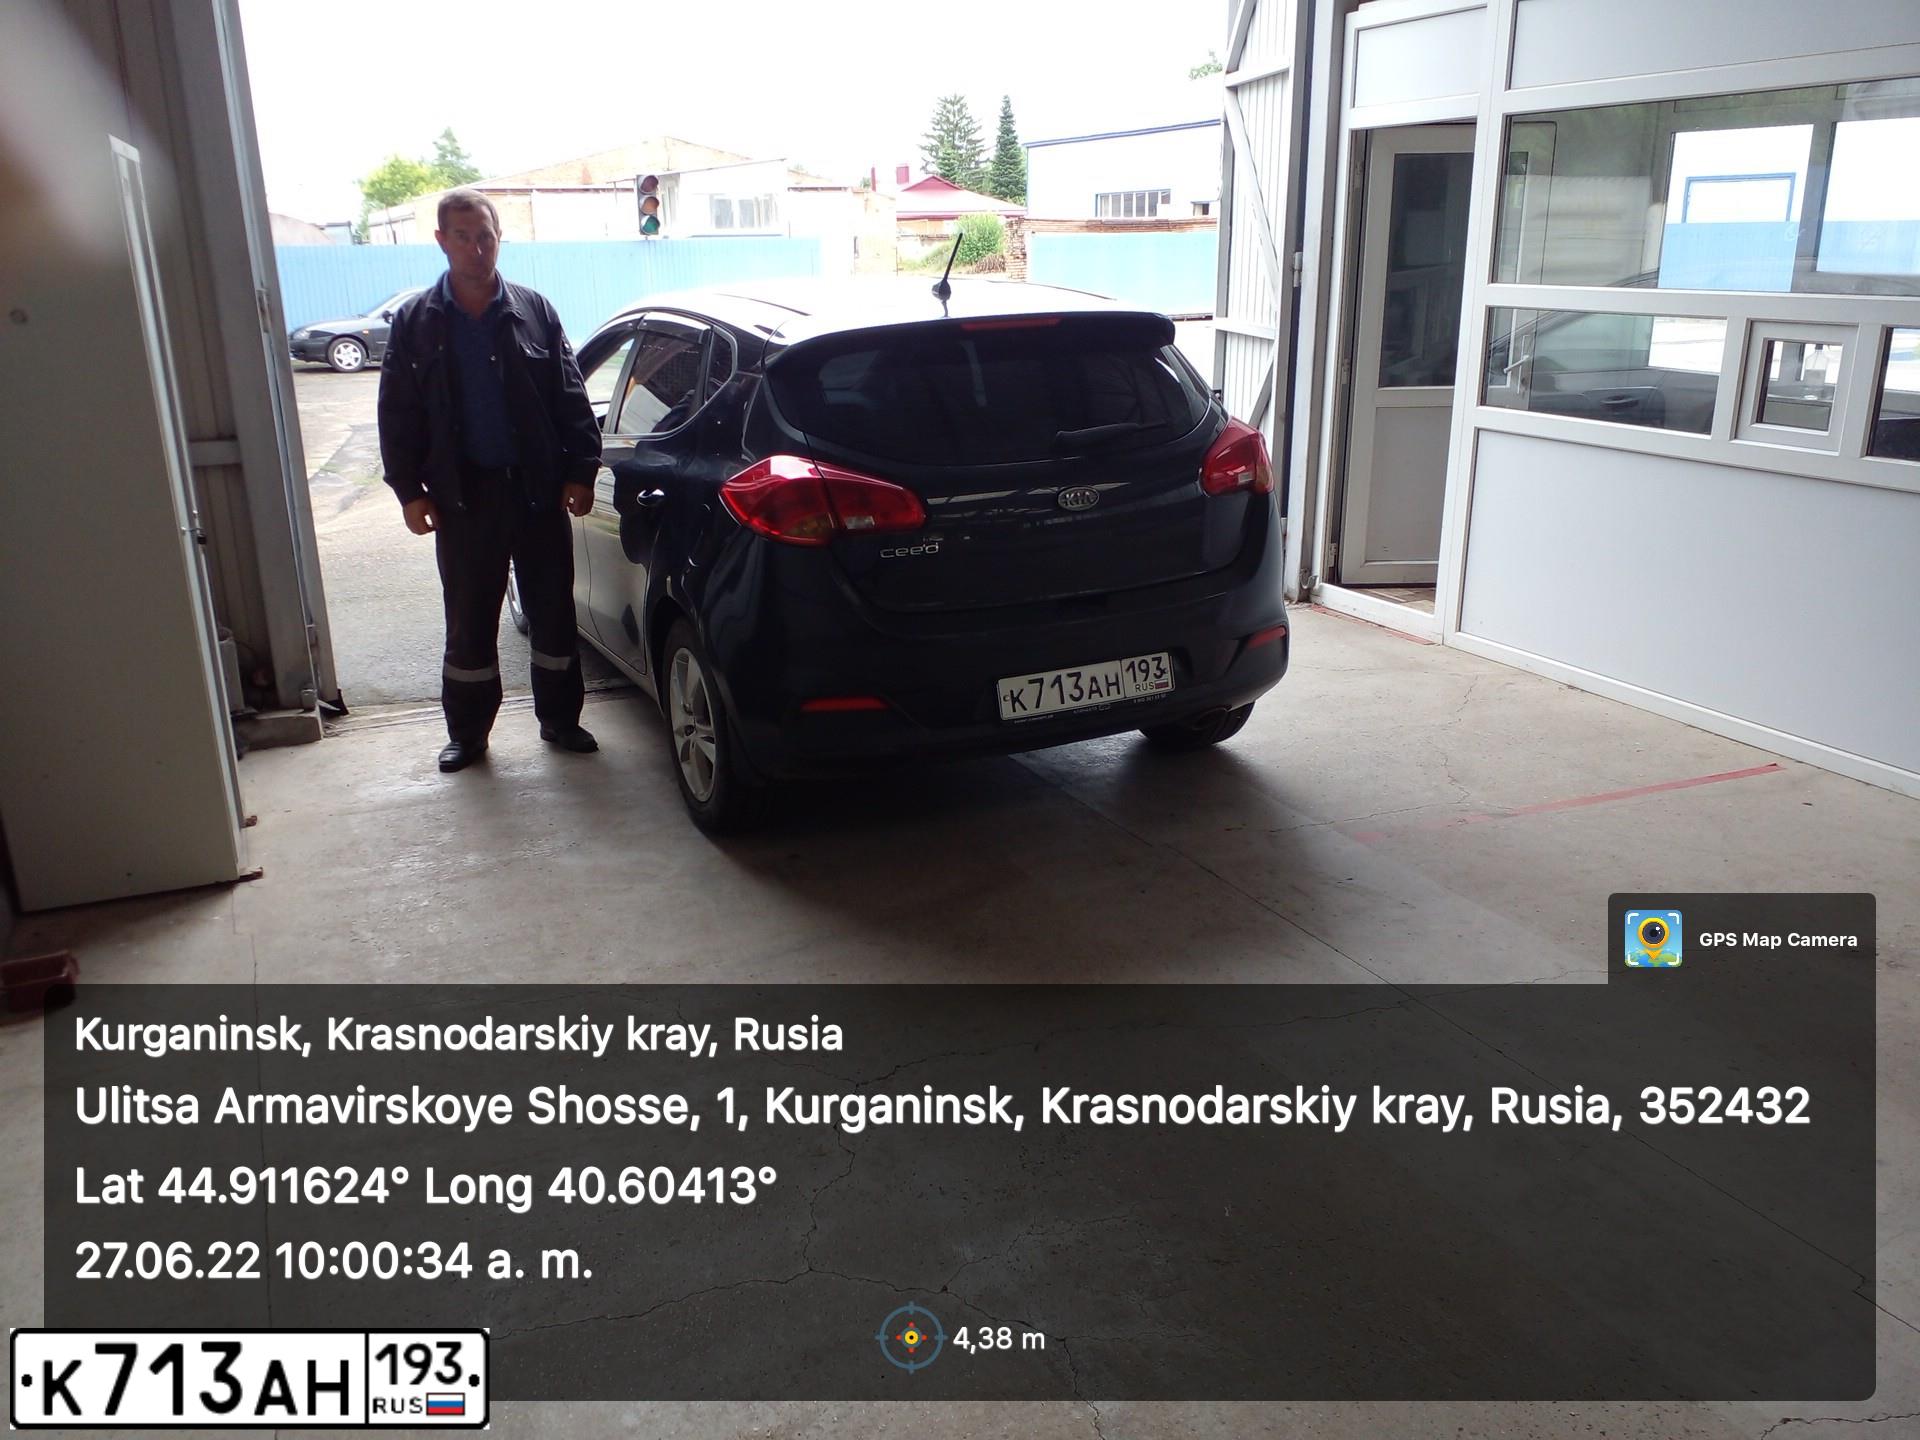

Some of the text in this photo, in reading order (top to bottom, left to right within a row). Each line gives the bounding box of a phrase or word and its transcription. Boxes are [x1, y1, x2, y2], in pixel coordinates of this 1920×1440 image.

[1009, 656, 1163, 713] K713AH 193
[1135, 681, 1155, 692] RUS
